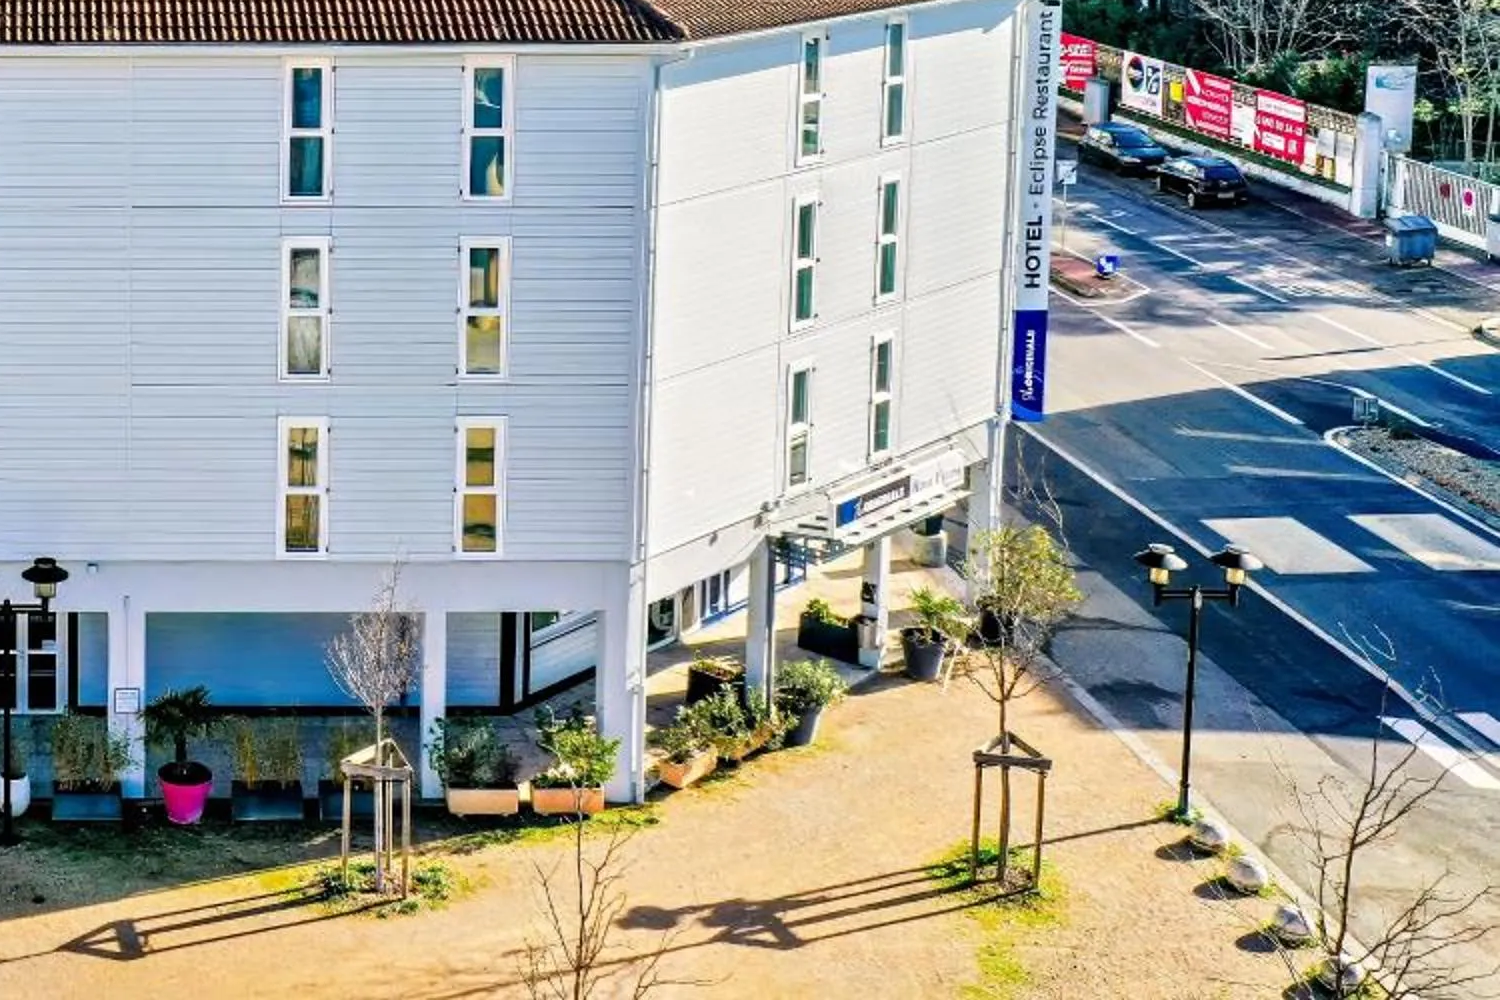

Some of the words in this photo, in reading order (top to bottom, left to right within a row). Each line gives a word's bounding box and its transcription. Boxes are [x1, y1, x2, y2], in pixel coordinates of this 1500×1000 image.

[1032, 11, 1053, 120] Restaurant
[1028, 126, 1048, 196] Eclipse
[1024, 215, 1043, 289] HOTEL
